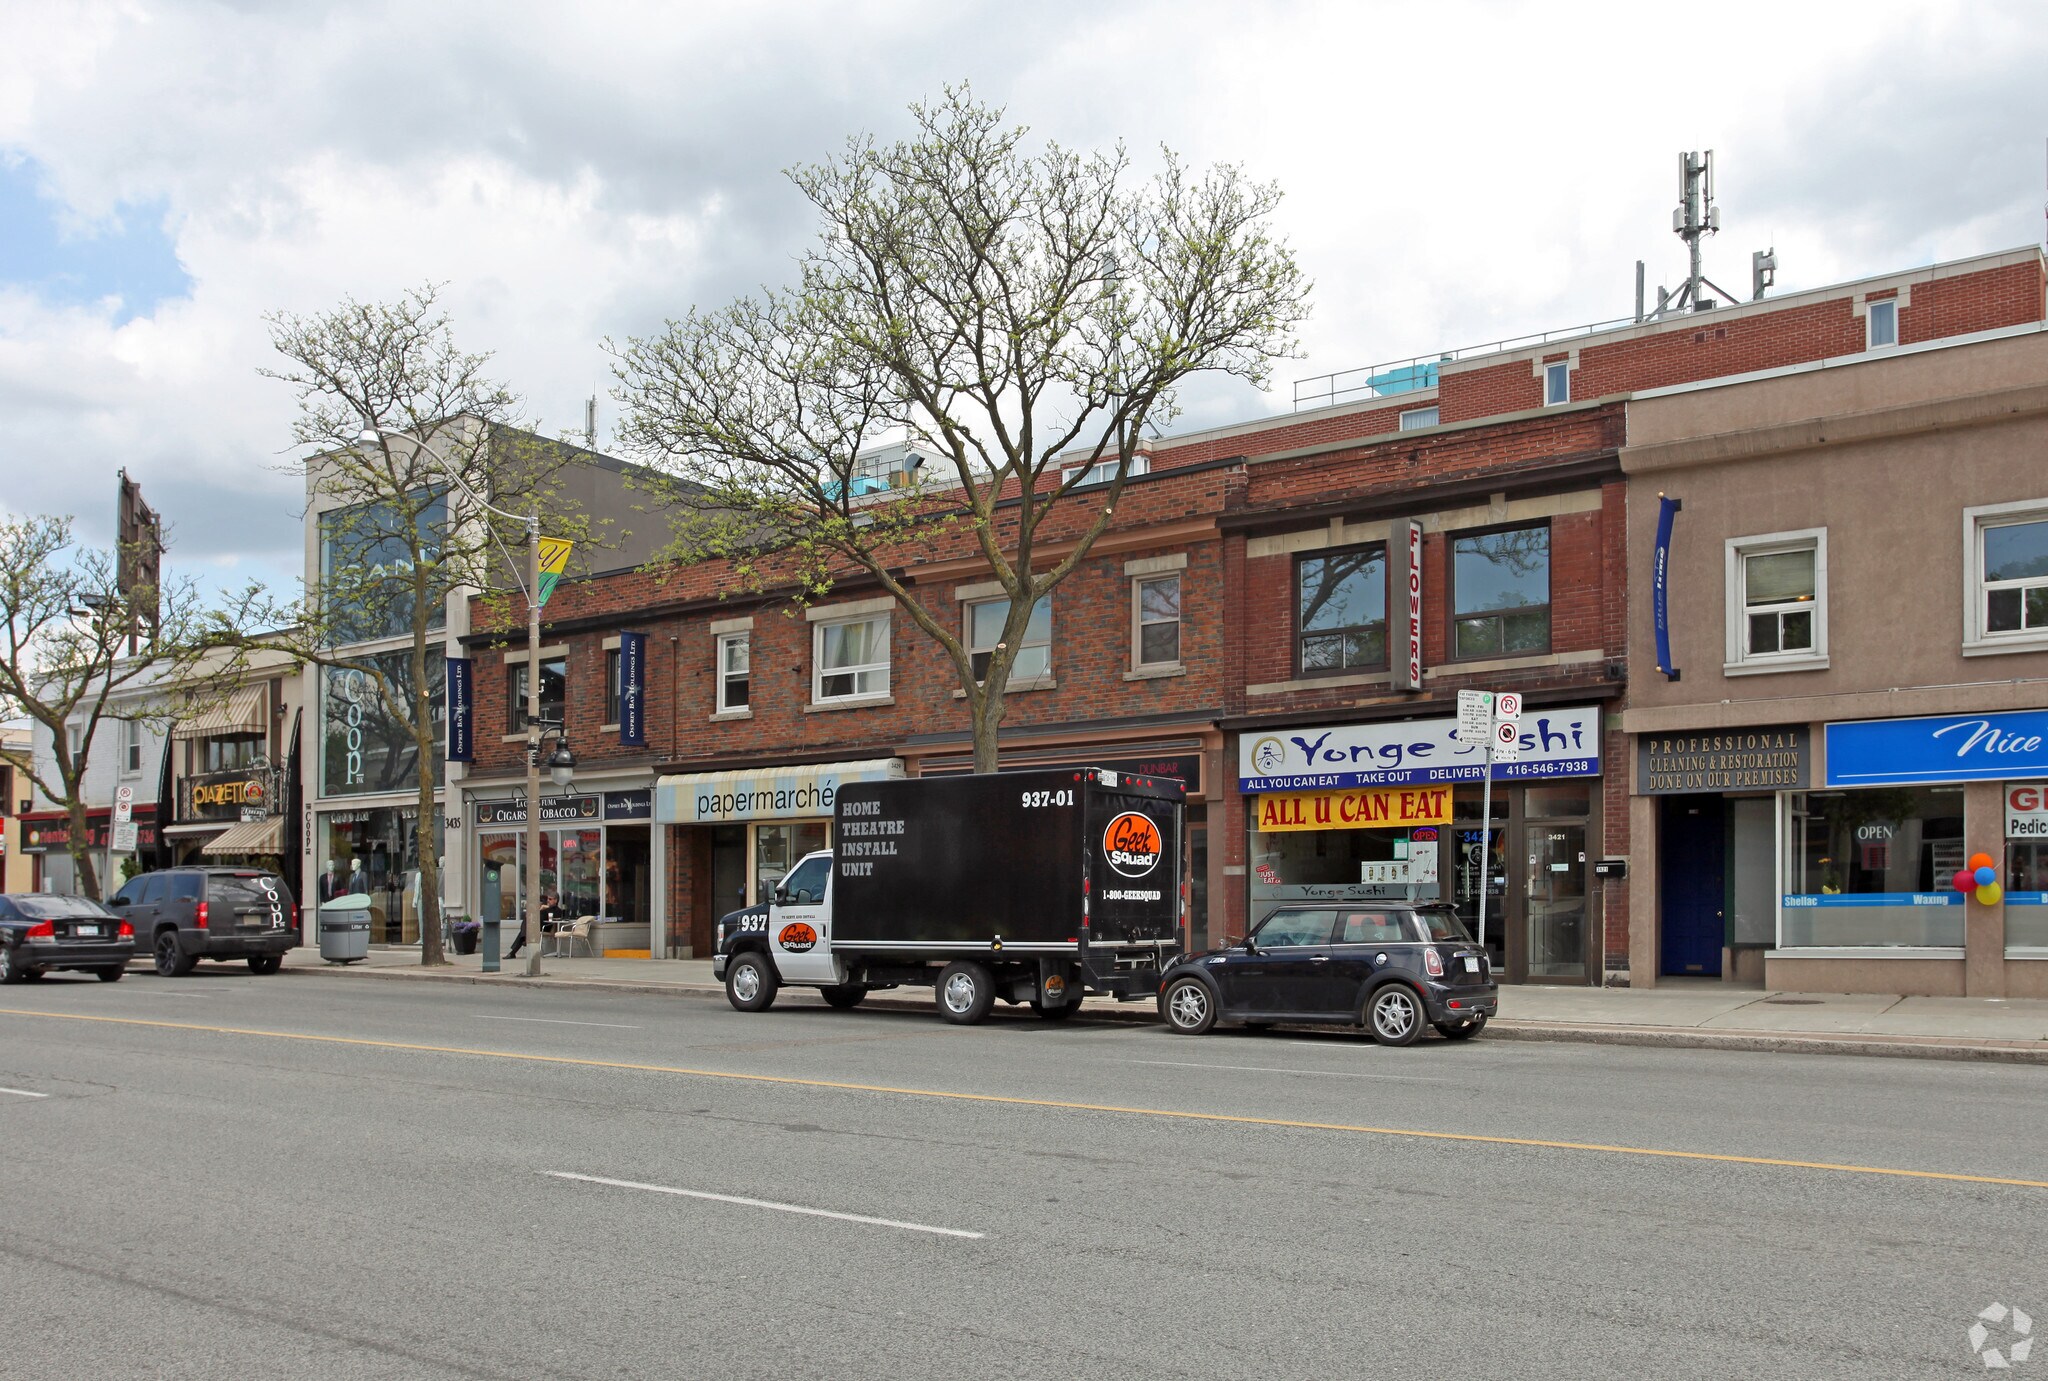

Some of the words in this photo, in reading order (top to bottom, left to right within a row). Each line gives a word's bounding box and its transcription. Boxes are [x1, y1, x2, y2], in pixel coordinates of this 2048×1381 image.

[1410, 528, 1419, 682] FLOWERS
[1650, 733, 1798, 755] PROFESSIONAL
[1932, 720, 2042, 757] Nice
[1290, 732, 1436, 770] Yonge
[1140, 763, 1178, 774] DUNBAR
[1650, 756, 1706, 772] CLEANING
[1710, 756, 1716, 770] &
[1720, 752, 1798, 770] RESTORATION
[1248, 779, 1267, 789] ALL
[1269, 778, 1291, 788] YOU
[1293, 776, 1316, 787] CAN
[1318, 776, 1340, 785] EAT
[1356, 772, 1385, 784] TAKE
[1388, 771, 1412, 782] OUT
[1430, 766, 1487, 780] DELIVERY
[1506, 761, 1588, 776] 416-546-7938
[1650, 774, 1682, 790] DONE
[1686, 774, 1702, 788] ON
[1708, 772, 1730, 786] OUR
[1736, 768, 1797, 786] PREMISES
[698, 780, 834, 820] papermarché
[1022, 790, 1074, 808] 937-01
[496, 810, 527, 822] CIGARS
[538, 808, 577, 819] TOBACCO
[842, 801, 880, 816] HOME
[1262, 798, 1306, 826] ALL
[1340, 793, 1390, 822] CAN
[1400, 790, 1447, 820] EAT
[445, 817, 461, 829] 3435
[842, 820, 904, 836] THEATRE
[1114, 817, 1152, 852] Geek
[1413, 832, 1438, 841] OPEN
[1858, 826, 1893, 840] OPEN
[564, 840, 577, 848] OPEN
[842, 841, 897, 856] INSTALL
[1111, 850, 1153, 866] Squad
[842, 862, 873, 876] UNIT
[1102, 890, 1161, 902] 1-800-GEEKSQUAD
[1301, 886, 1344, 898] Yonge
[1350, 886, 1386, 896] Sushi
[1913, 894, 1949, 905] Waxing
[1784, 896, 1818, 907] Shellac
[741, 914, 767, 932] 937
[784, 924, 812, 942] Geek
